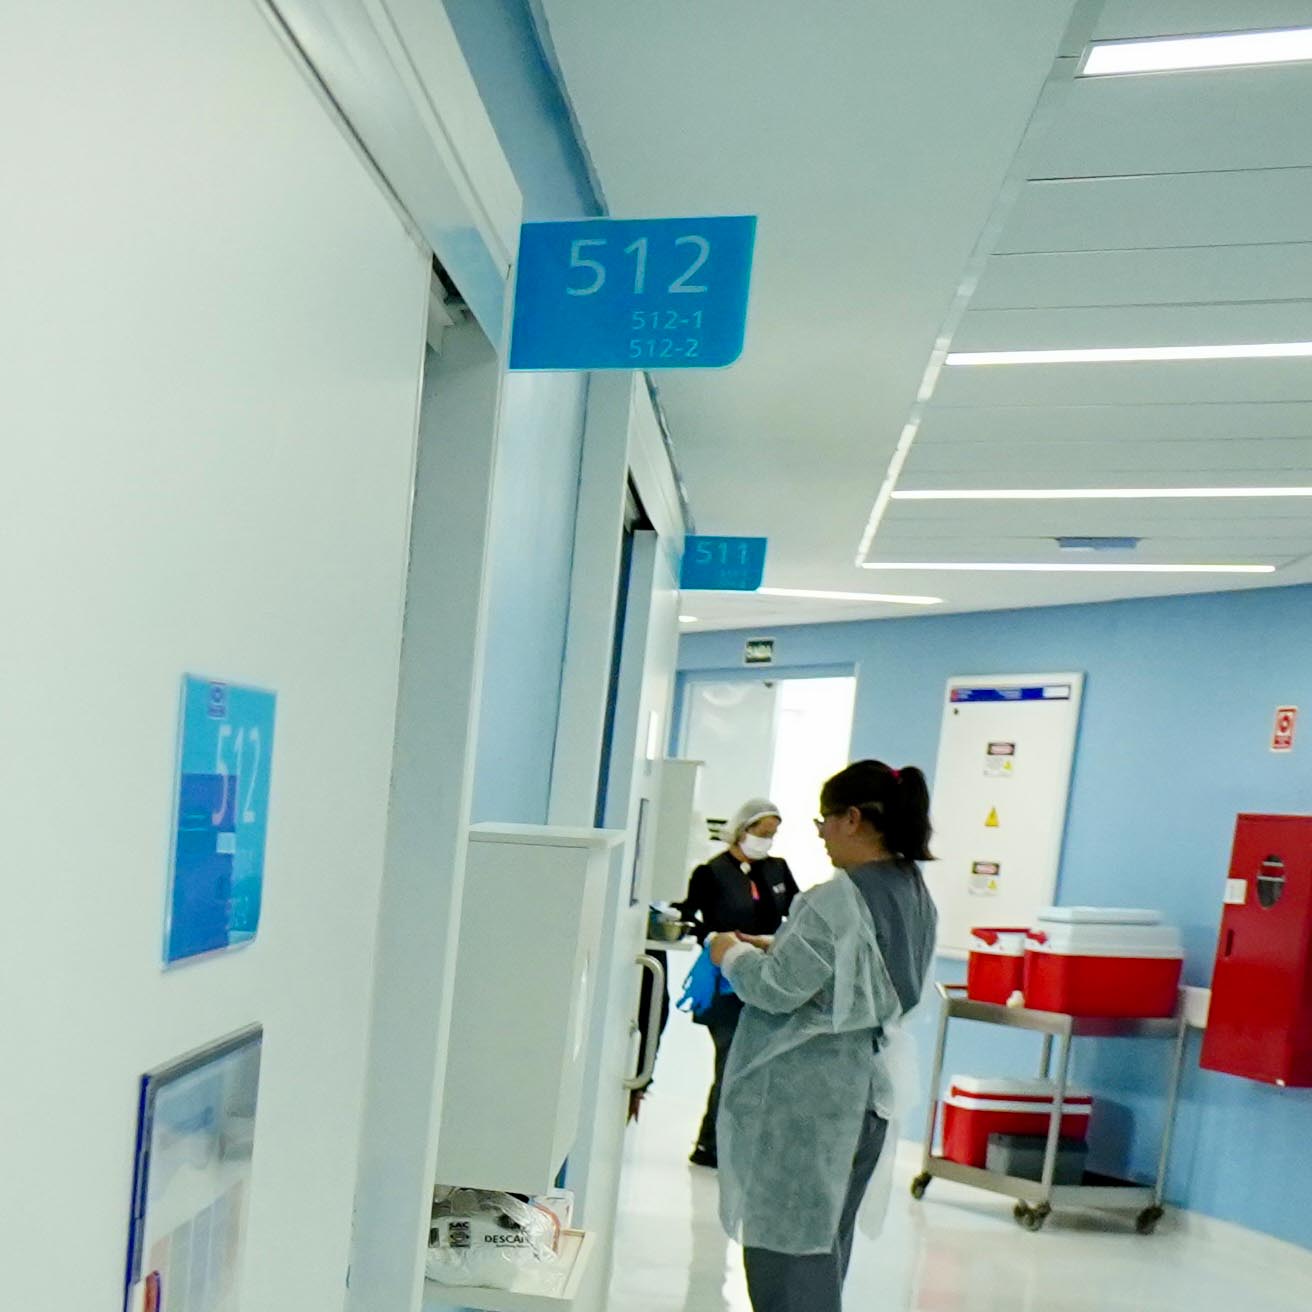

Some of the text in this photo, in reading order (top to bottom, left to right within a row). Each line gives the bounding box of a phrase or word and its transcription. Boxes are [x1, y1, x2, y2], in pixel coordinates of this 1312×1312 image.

[566, 235, 711, 297] 512
[631, 310, 704, 330] 512-1
[629, 338, 700, 358] 512-2
[695, 541, 749, 565] 511
[211, 723, 263, 826] 512
